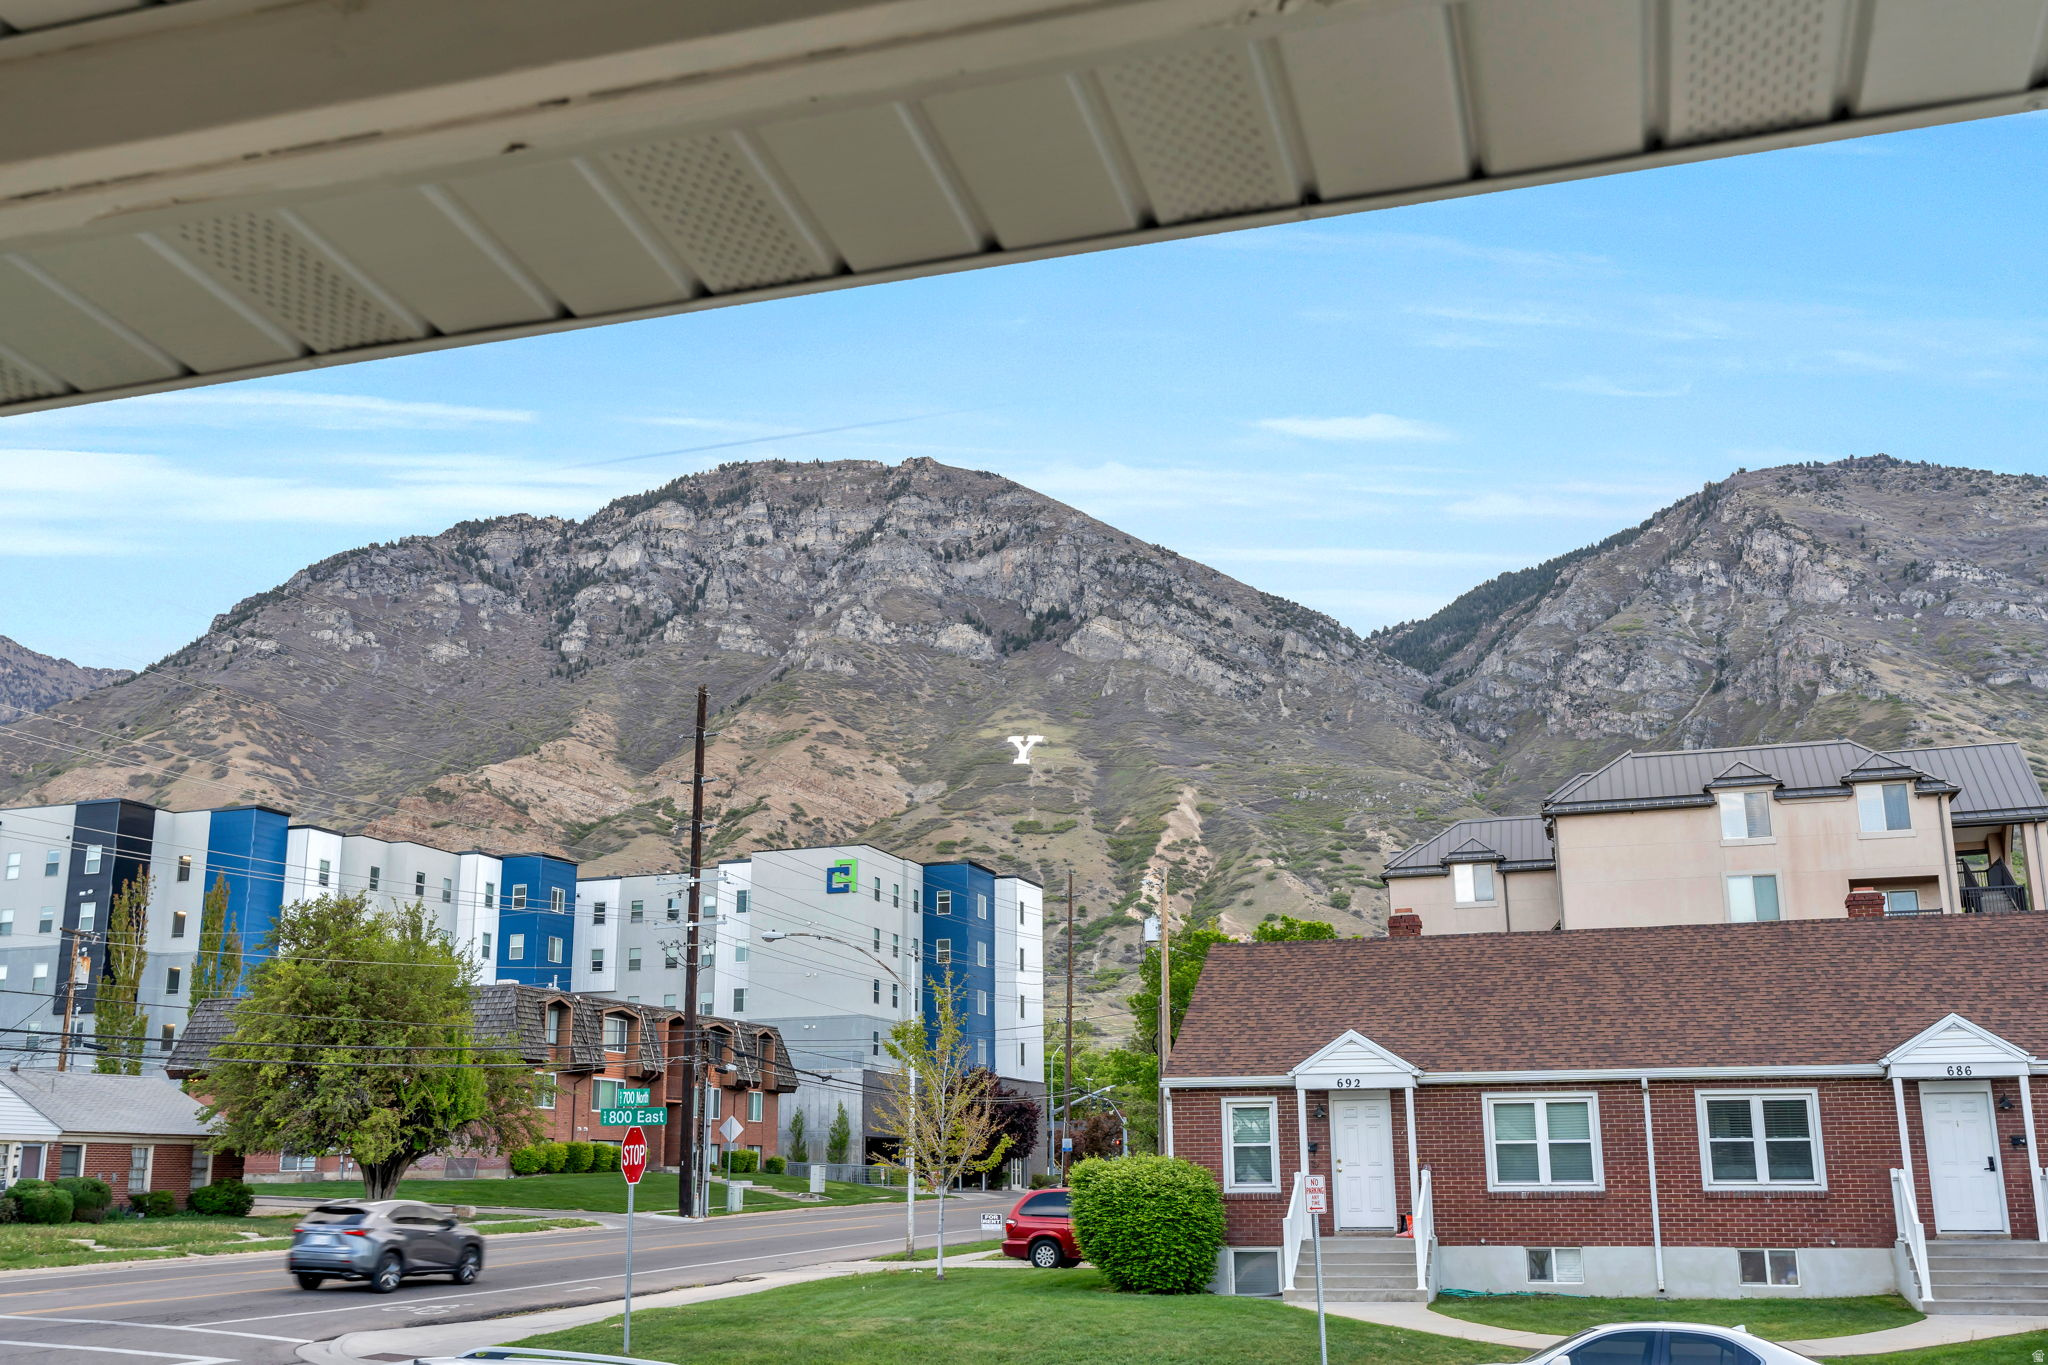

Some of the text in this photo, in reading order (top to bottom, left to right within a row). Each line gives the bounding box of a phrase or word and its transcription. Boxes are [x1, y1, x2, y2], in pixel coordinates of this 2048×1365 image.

[1007, 735, 1044, 765] Y
[1947, 1065, 1972, 1076] 686
[1337, 1078, 1360, 1088] 692
[623, 1091, 635, 1104] 700
[636, 1091, 649, 1104] North
[609, 1110, 632, 1124] 800
[637, 1110, 664, 1123] East
[623, 1144, 645, 1166] STOP
[1310, 1178, 1319, 1186] NO
[1306, 1187, 1324, 1195] PARKING
